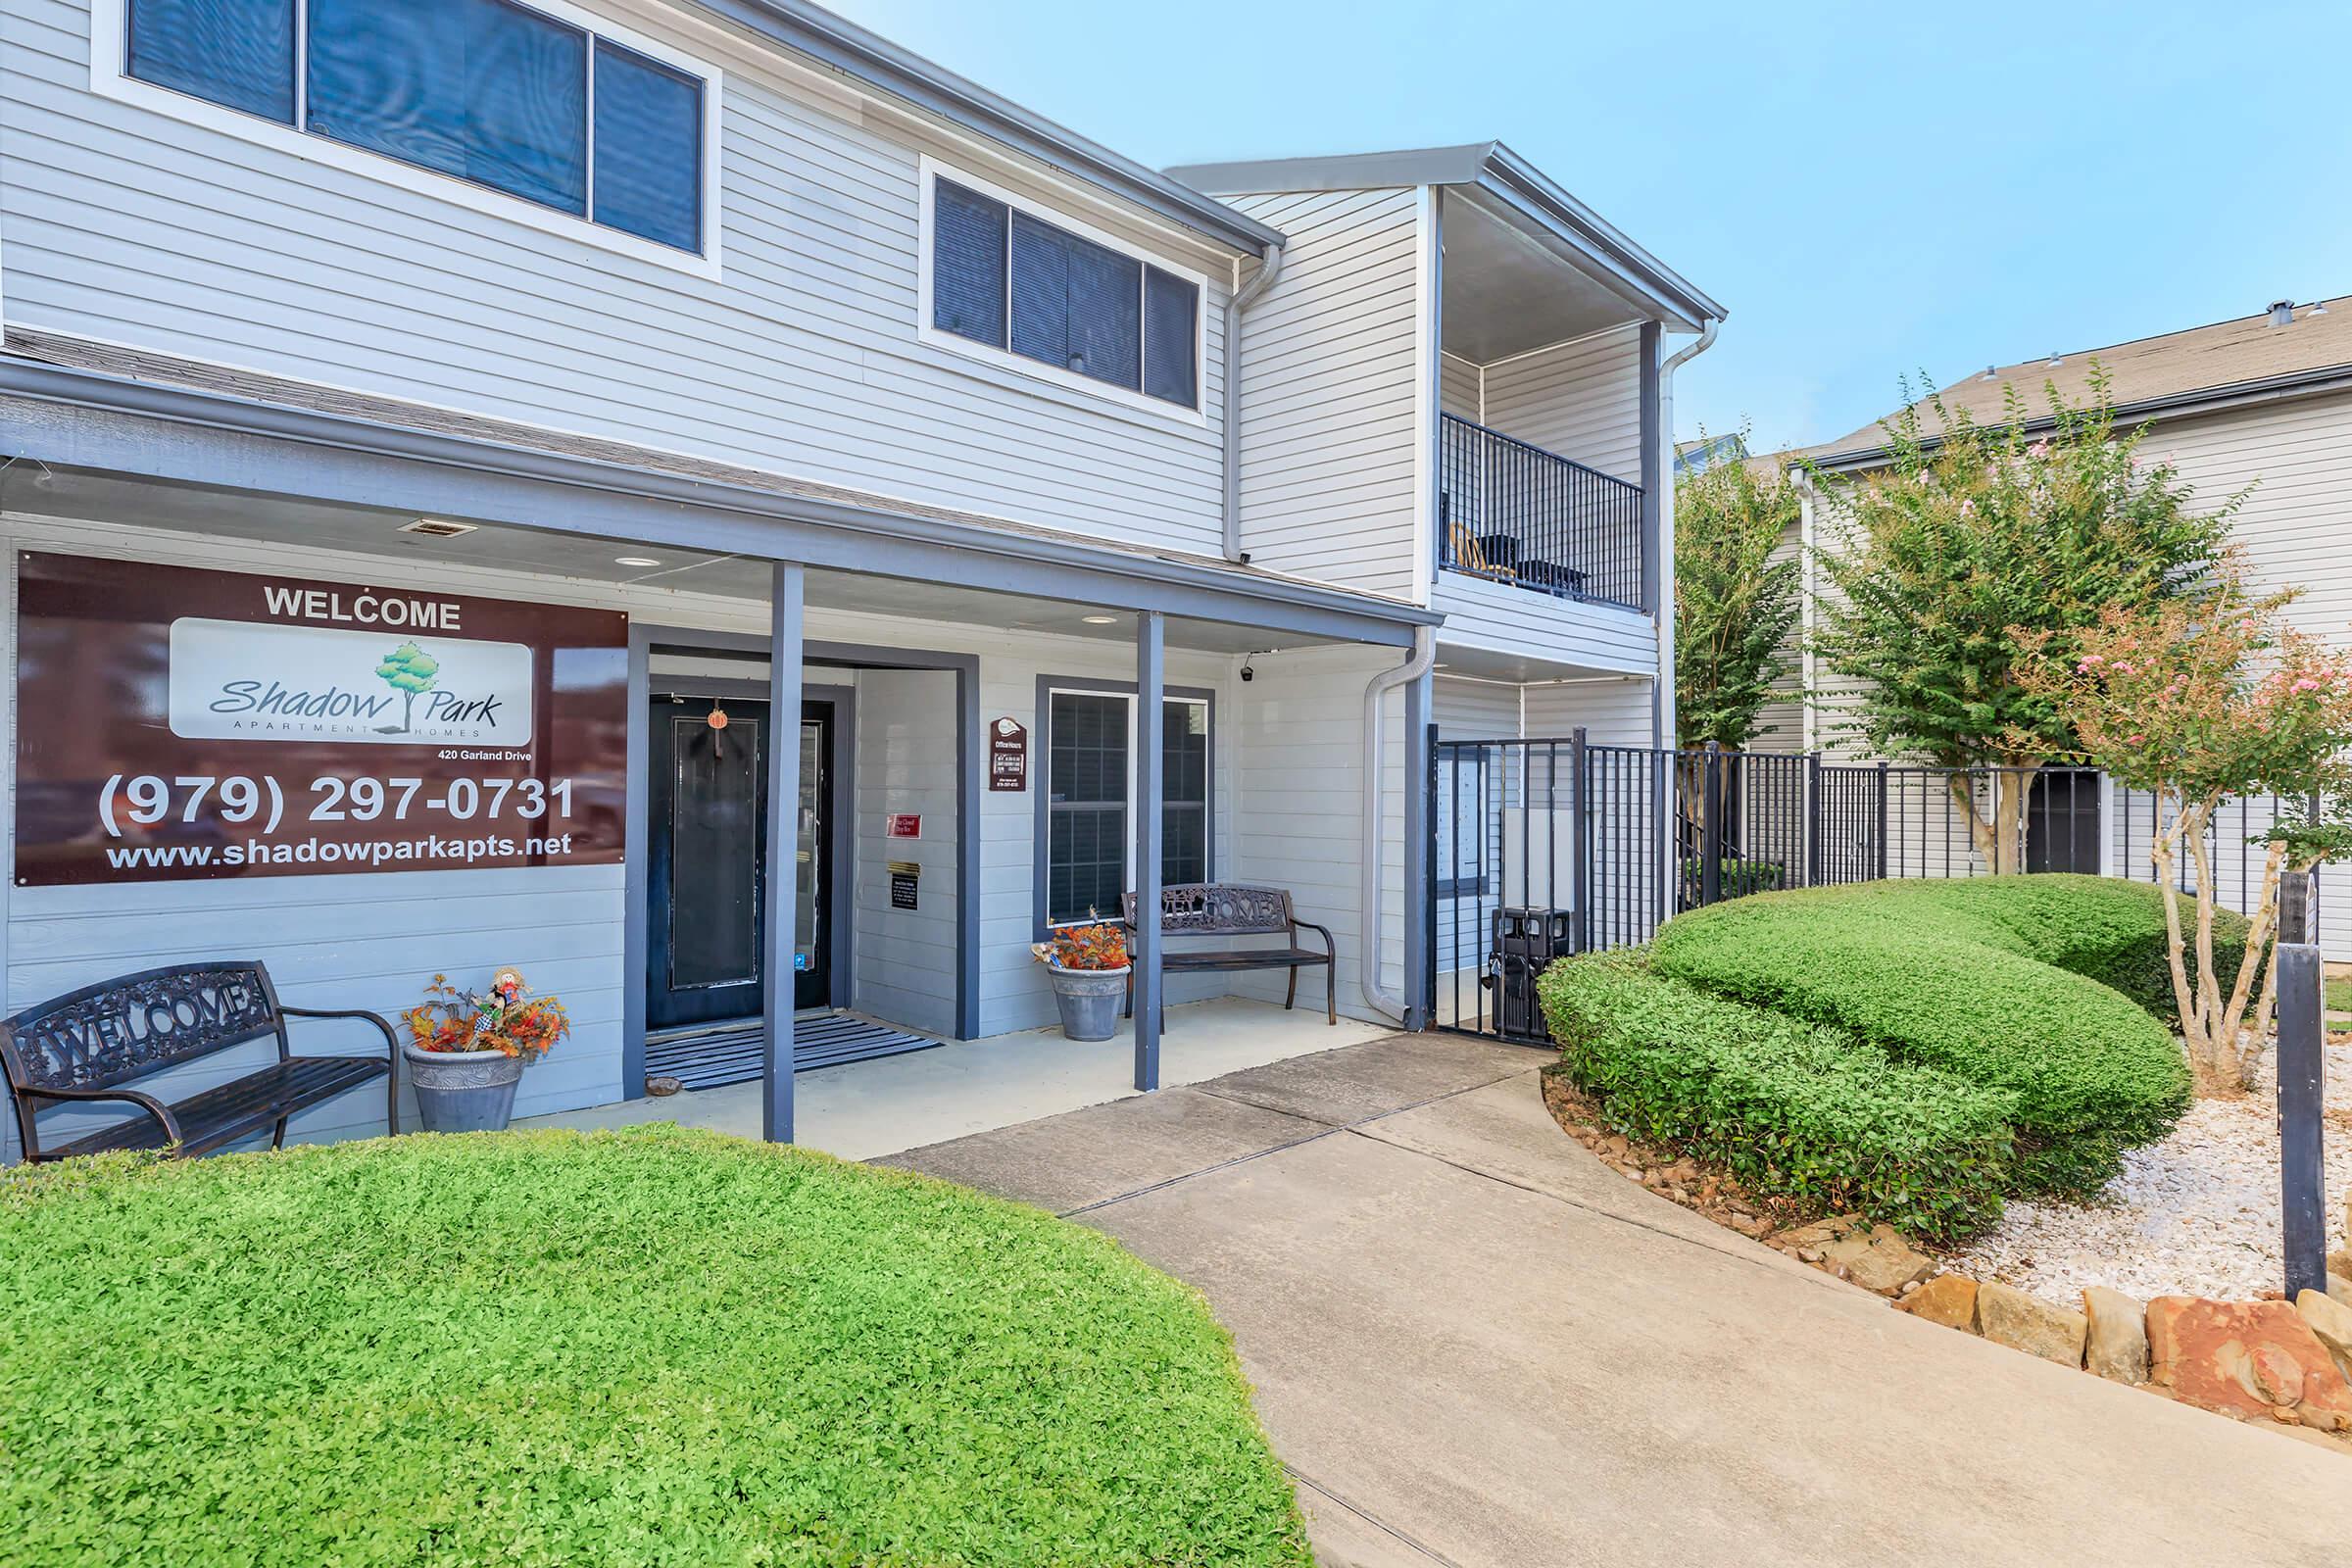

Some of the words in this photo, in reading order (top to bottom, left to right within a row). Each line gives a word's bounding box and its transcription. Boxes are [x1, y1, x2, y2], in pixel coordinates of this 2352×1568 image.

[264, 586, 462, 630] WELCOME
[209, 680, 393, 718] Shadow
[424, 691, 503, 728] Park
[233, 720, 368, 734] APARTMENT
[415, 728, 479, 737] HOMES
[438, 750, 458, 760] 420
[460, 750, 503, 760] Garland
[505, 751, 532, 761] Drive
[99, 774, 284, 837] (979)
[308, 776, 572, 821] 297-0731
[106, 833, 571, 869] www.shadowparkapts.net
[41, 981, 251, 1068] WELCOME
